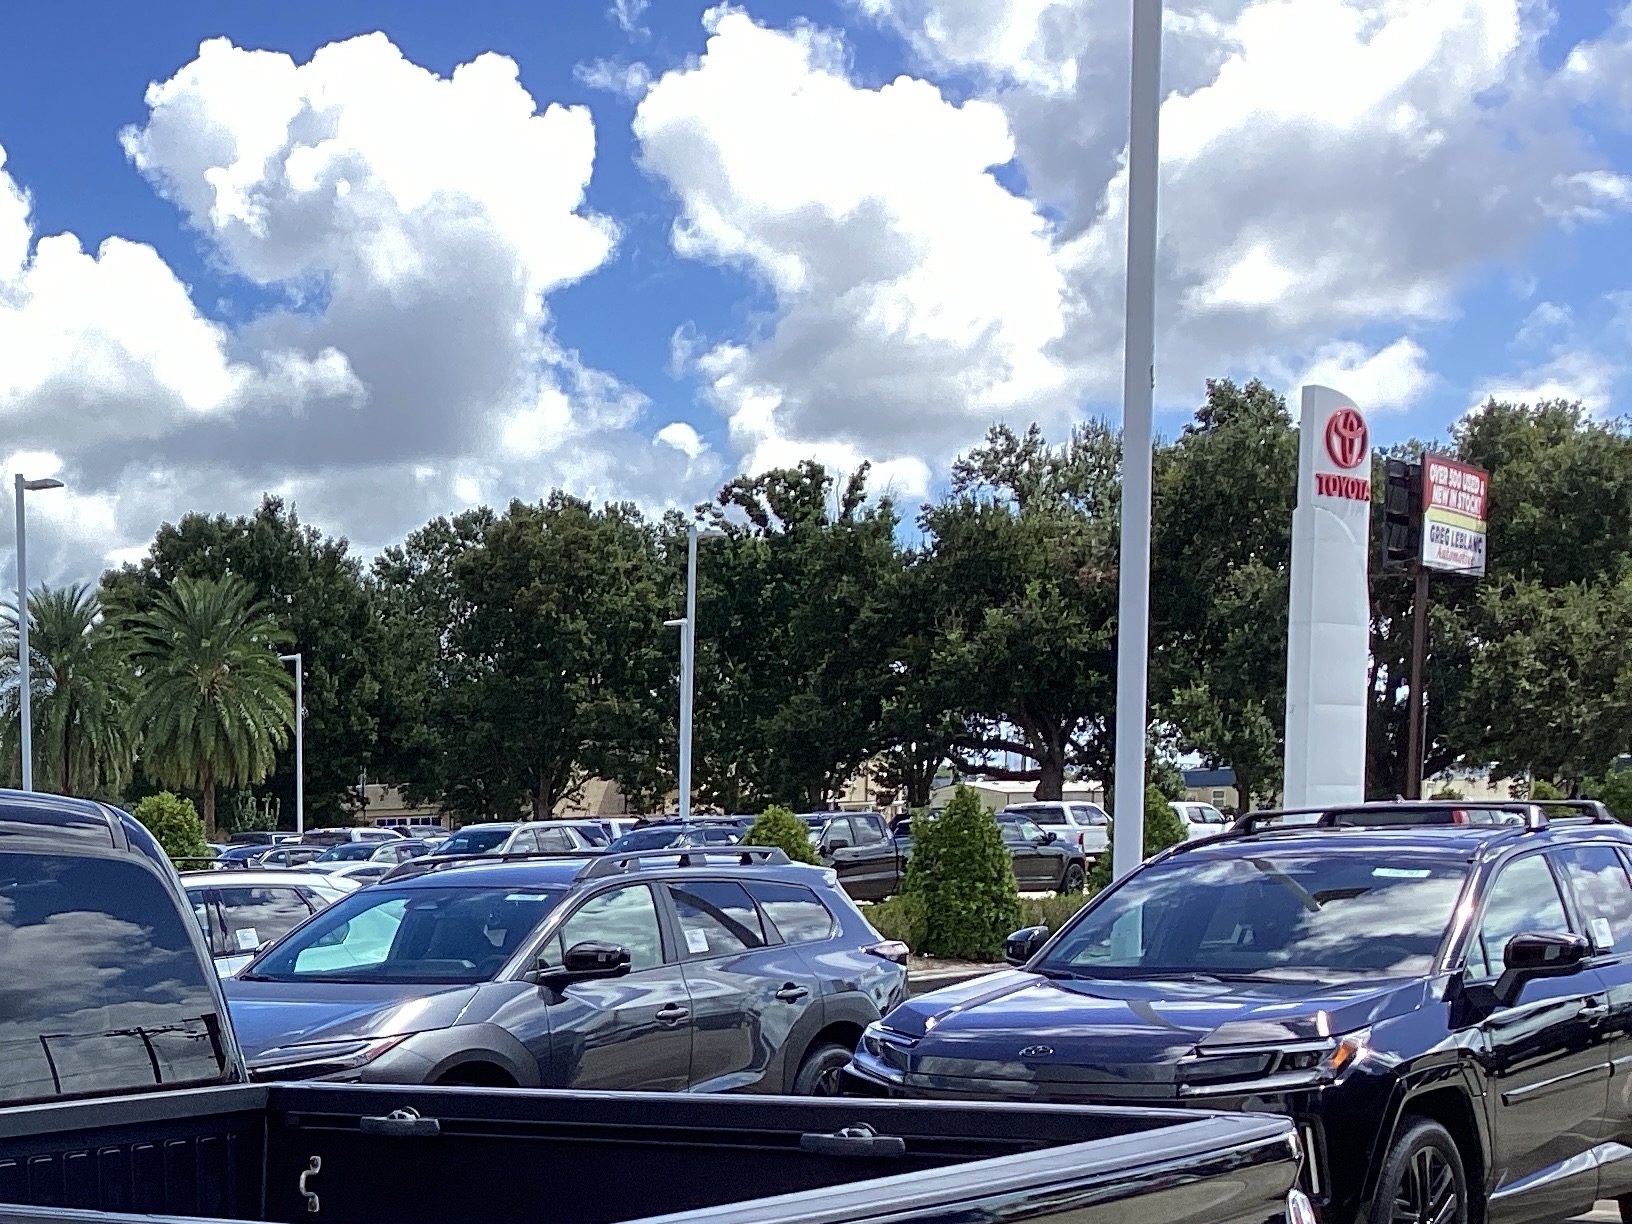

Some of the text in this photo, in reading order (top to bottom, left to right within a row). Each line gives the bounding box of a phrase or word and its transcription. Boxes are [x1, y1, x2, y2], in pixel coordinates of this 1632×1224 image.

[1315, 473, 1370, 502] TOYOTA
[1429, 524, 1483, 554] GREG LEBLANC
